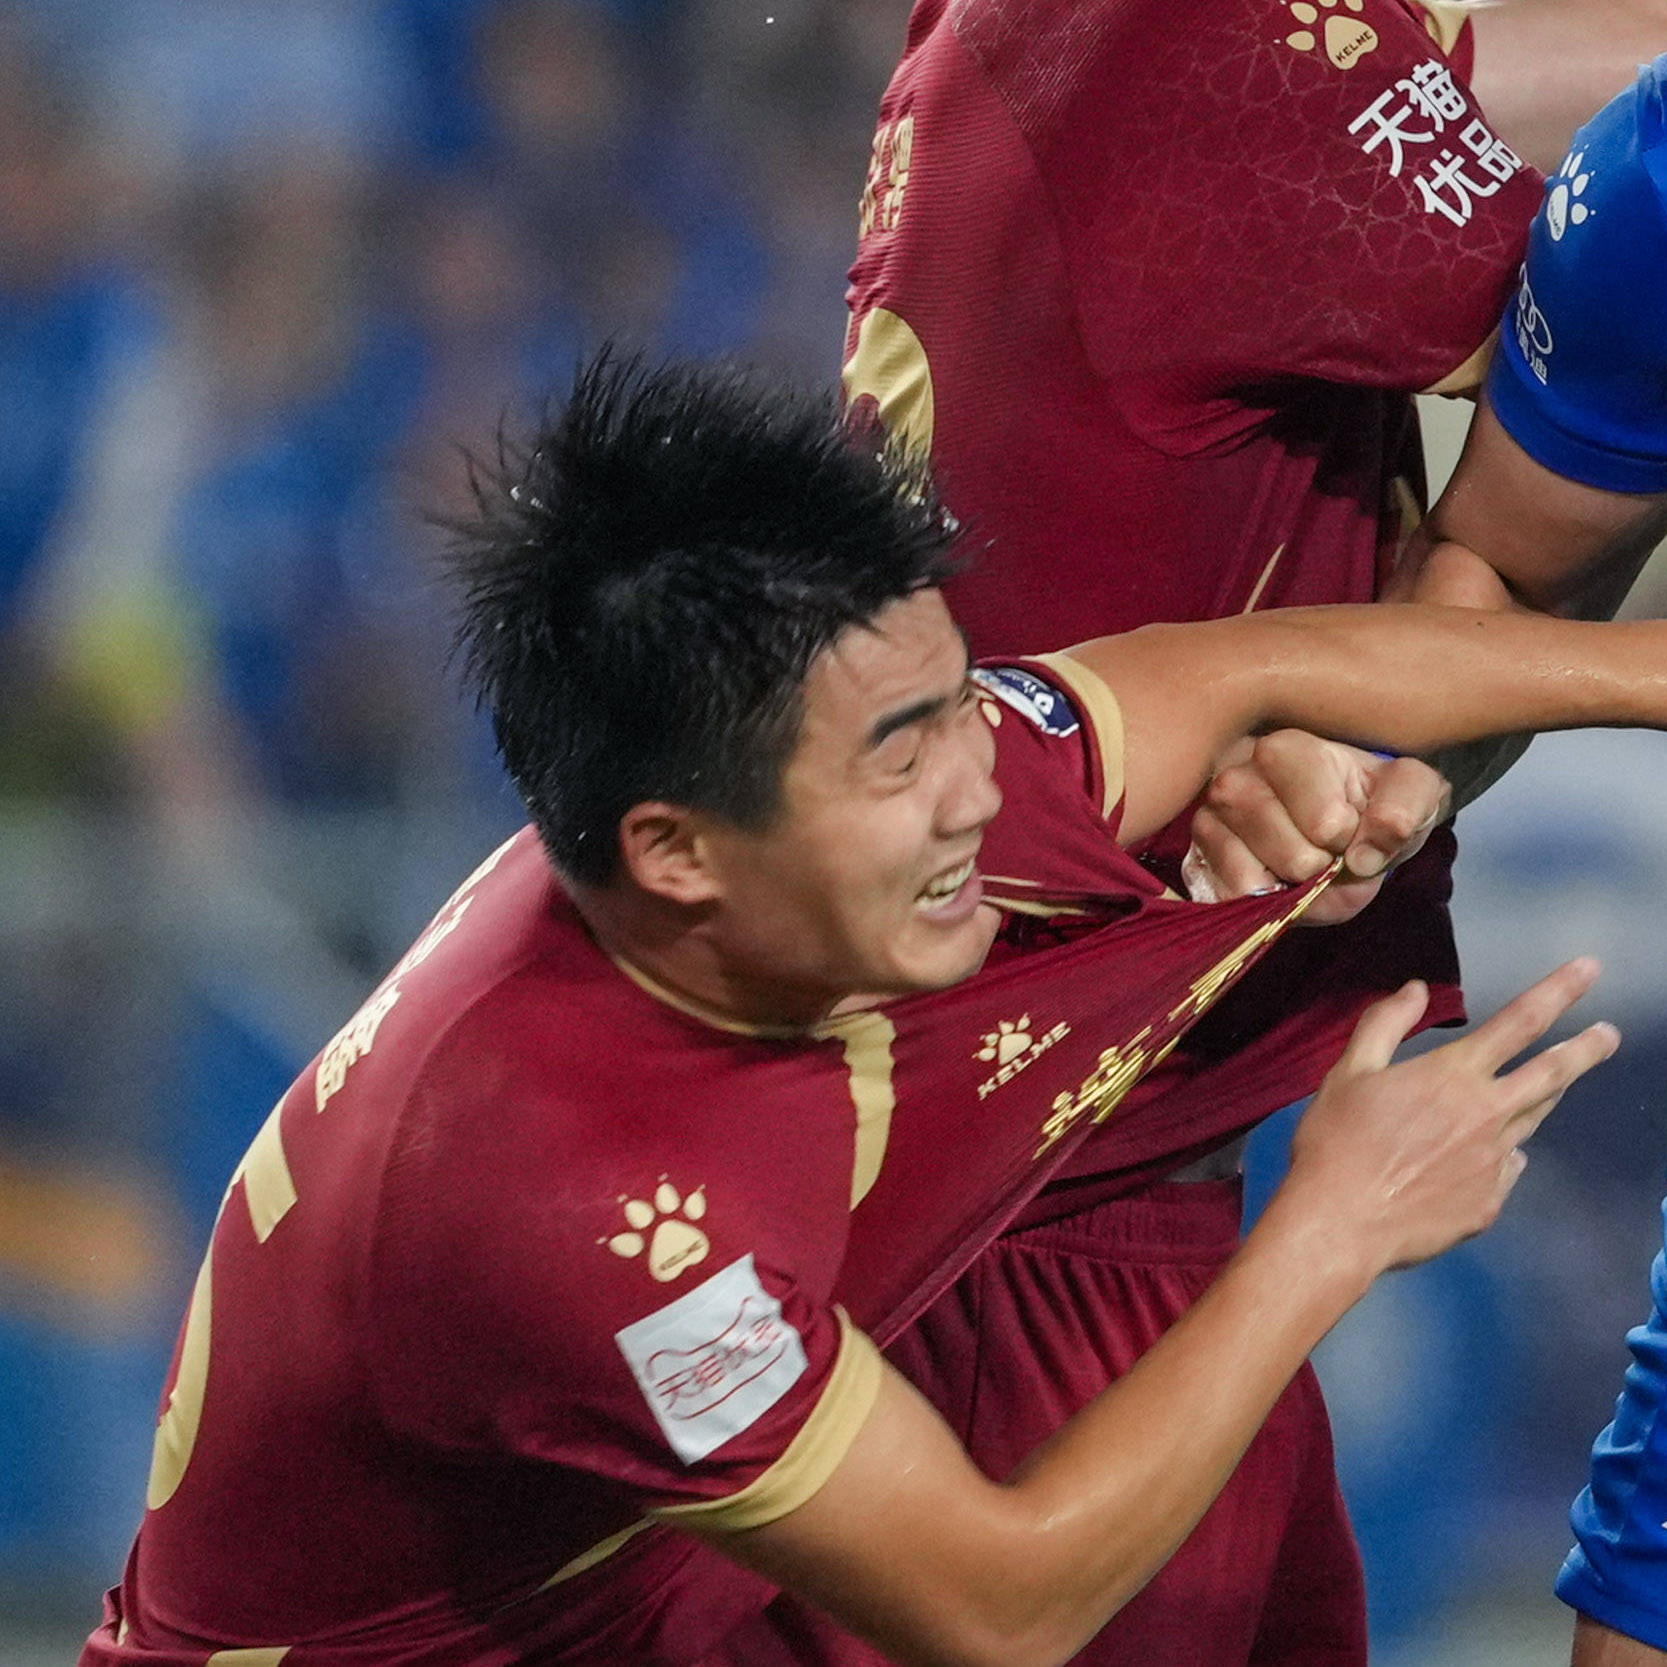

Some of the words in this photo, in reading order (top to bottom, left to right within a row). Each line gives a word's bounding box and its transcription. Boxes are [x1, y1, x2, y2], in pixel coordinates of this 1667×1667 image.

[1335, 30, 1374, 62] KELME
[1347, 58, 1468, 177] 天猫
[1413, 119, 1523, 227] 优品
[977, 1021, 1072, 1100] KELME
